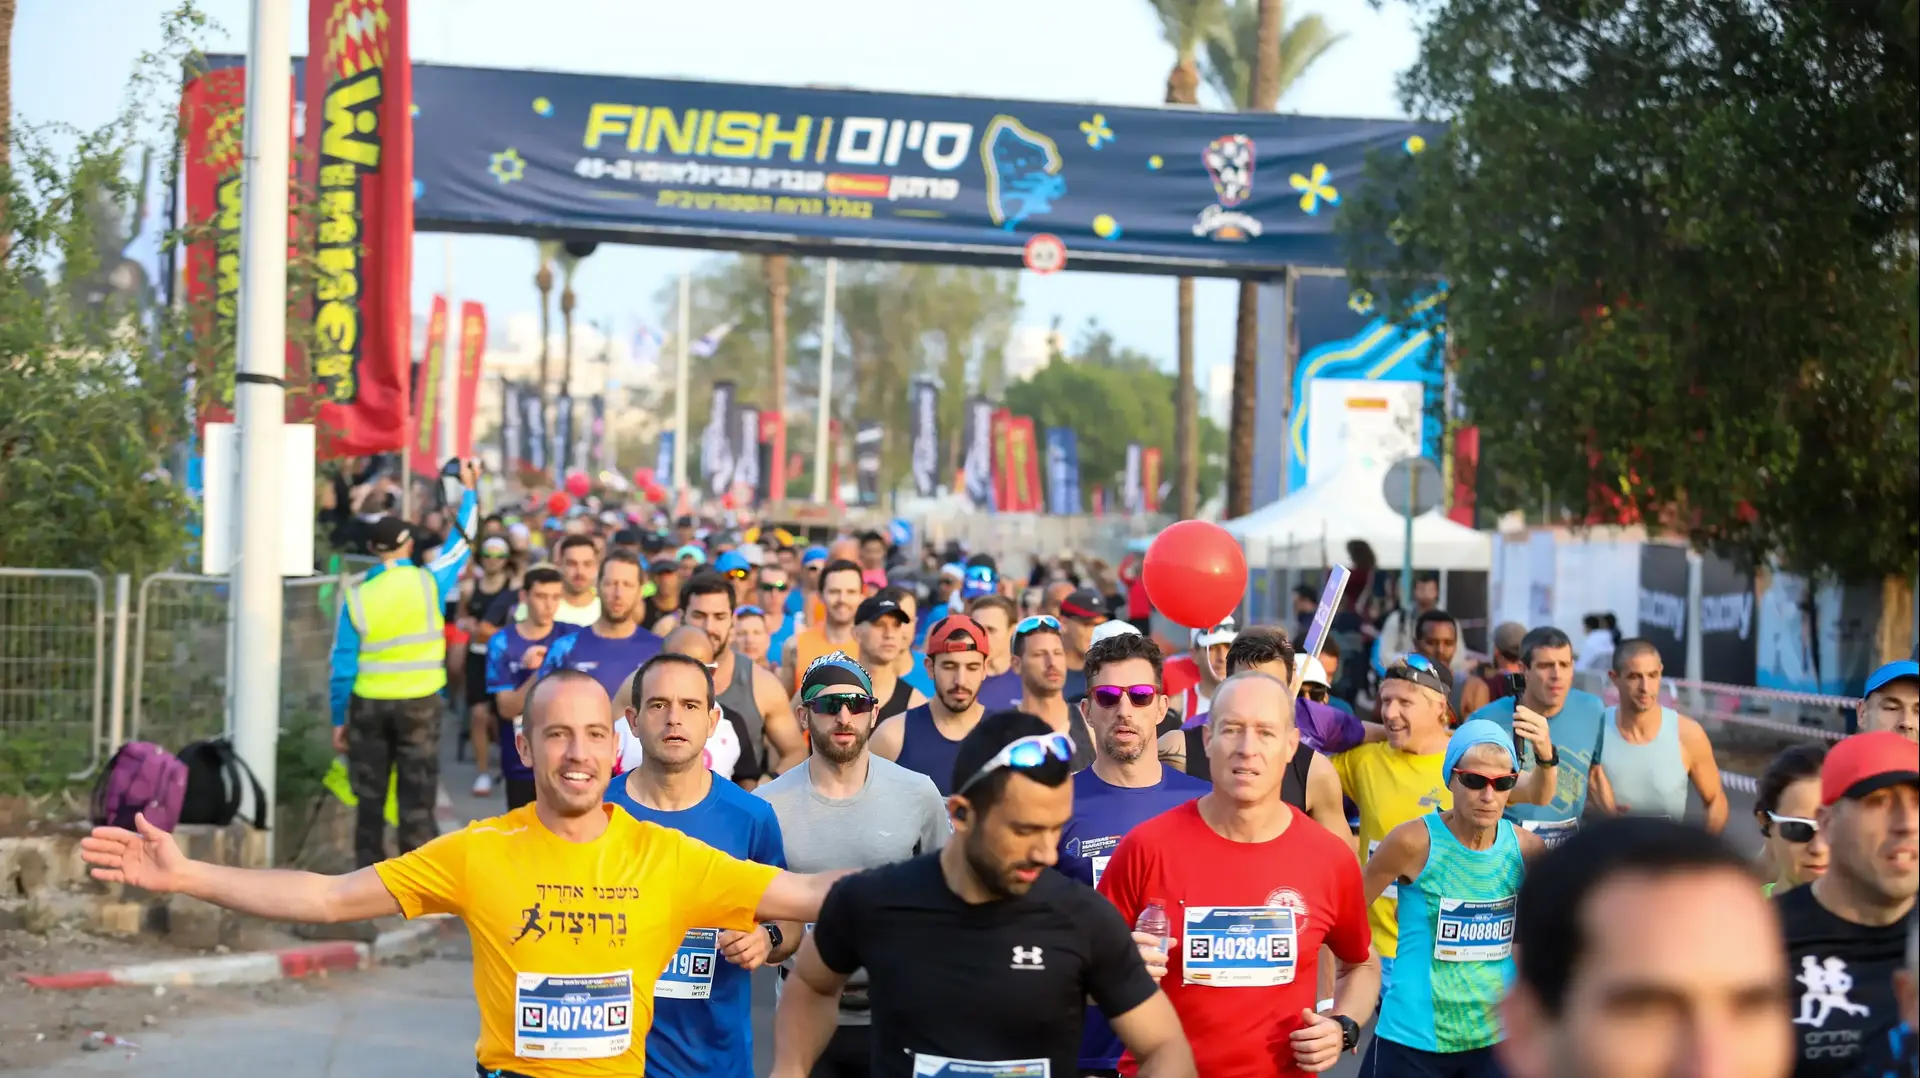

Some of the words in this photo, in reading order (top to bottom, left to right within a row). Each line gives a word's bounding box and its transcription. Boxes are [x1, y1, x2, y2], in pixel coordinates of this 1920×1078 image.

[583, 102, 814, 163] FINISH
[834, 115, 974, 171] סיום
[1461, 921, 1500, 941] 40888
[1214, 936, 1268, 960] 40284
[662, 953, 690, 975] 19
[548, 1004, 604, 1032] 40742
